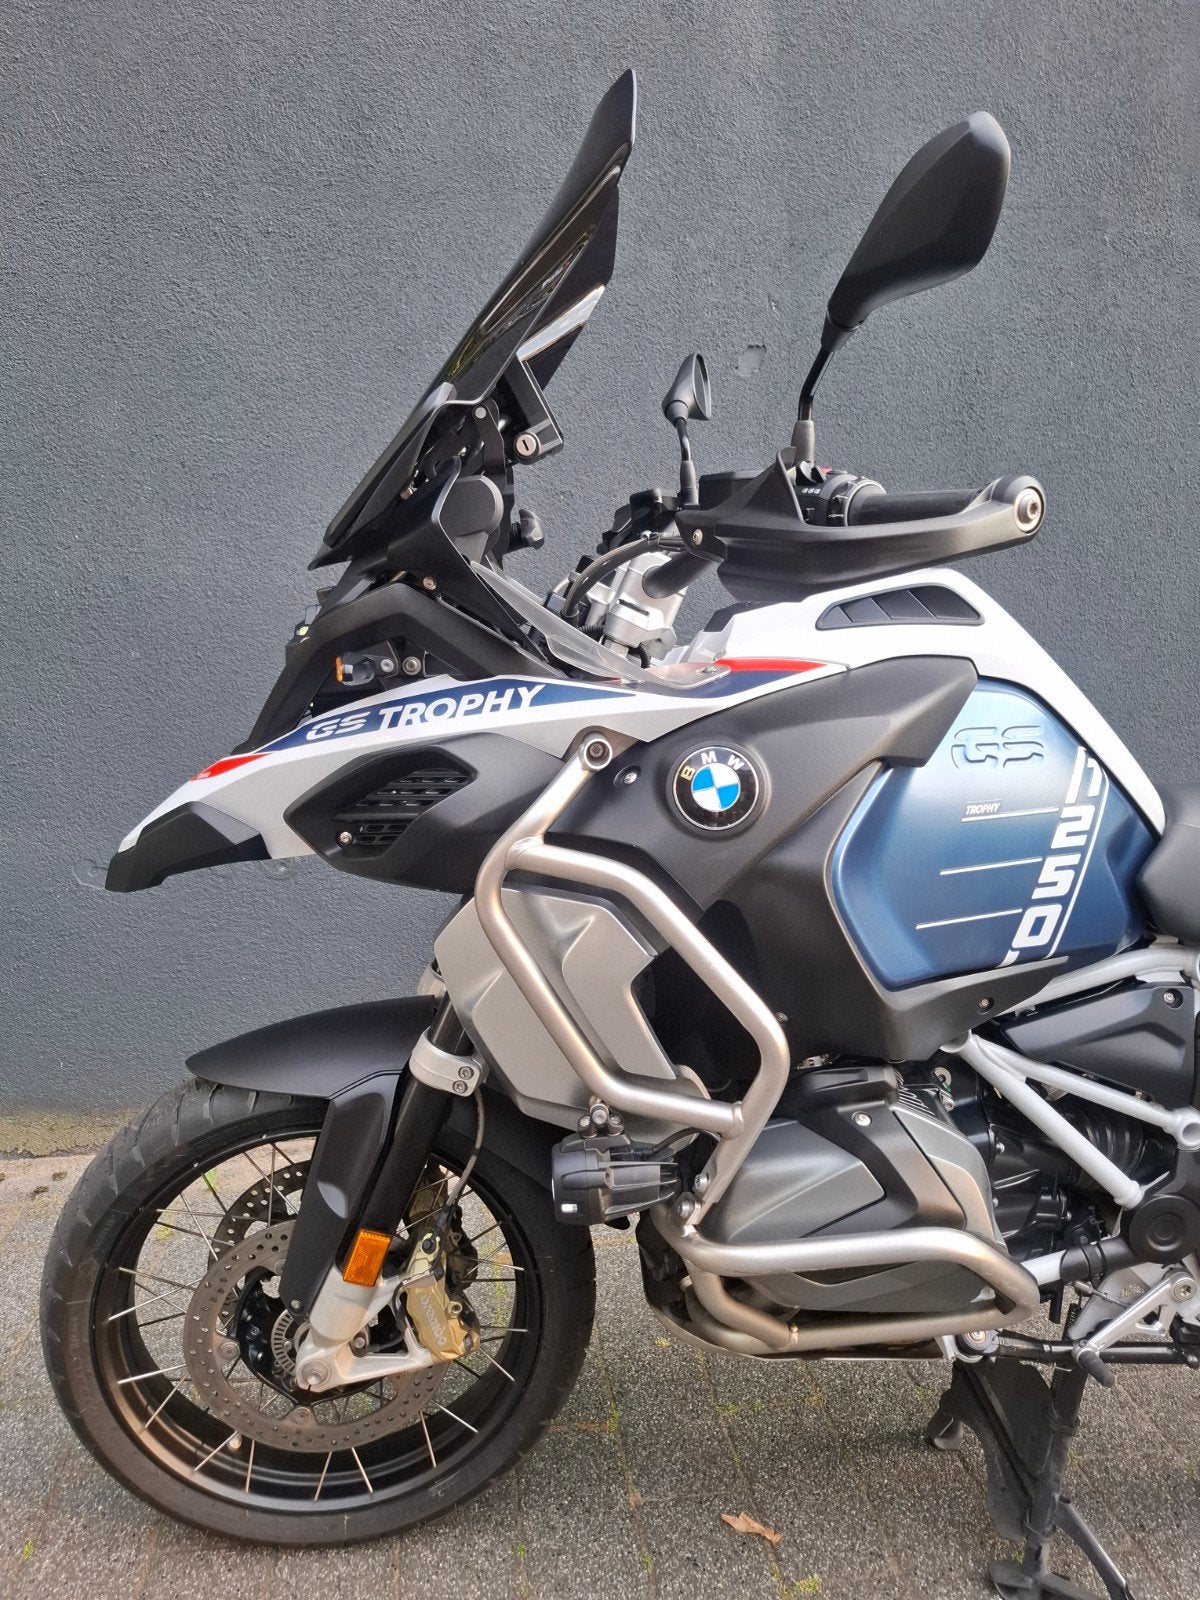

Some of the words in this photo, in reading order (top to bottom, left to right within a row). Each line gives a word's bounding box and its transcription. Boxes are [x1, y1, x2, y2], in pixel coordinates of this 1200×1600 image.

[306, 711, 371, 741] GS
[378, 684, 546, 731] TROPHY
[680, 750, 745, 781] BMW
[951, 725, 1044, 769] GS
[965, 802, 1001, 815] TROPHY
[1012, 757, 1102, 949] 1250
